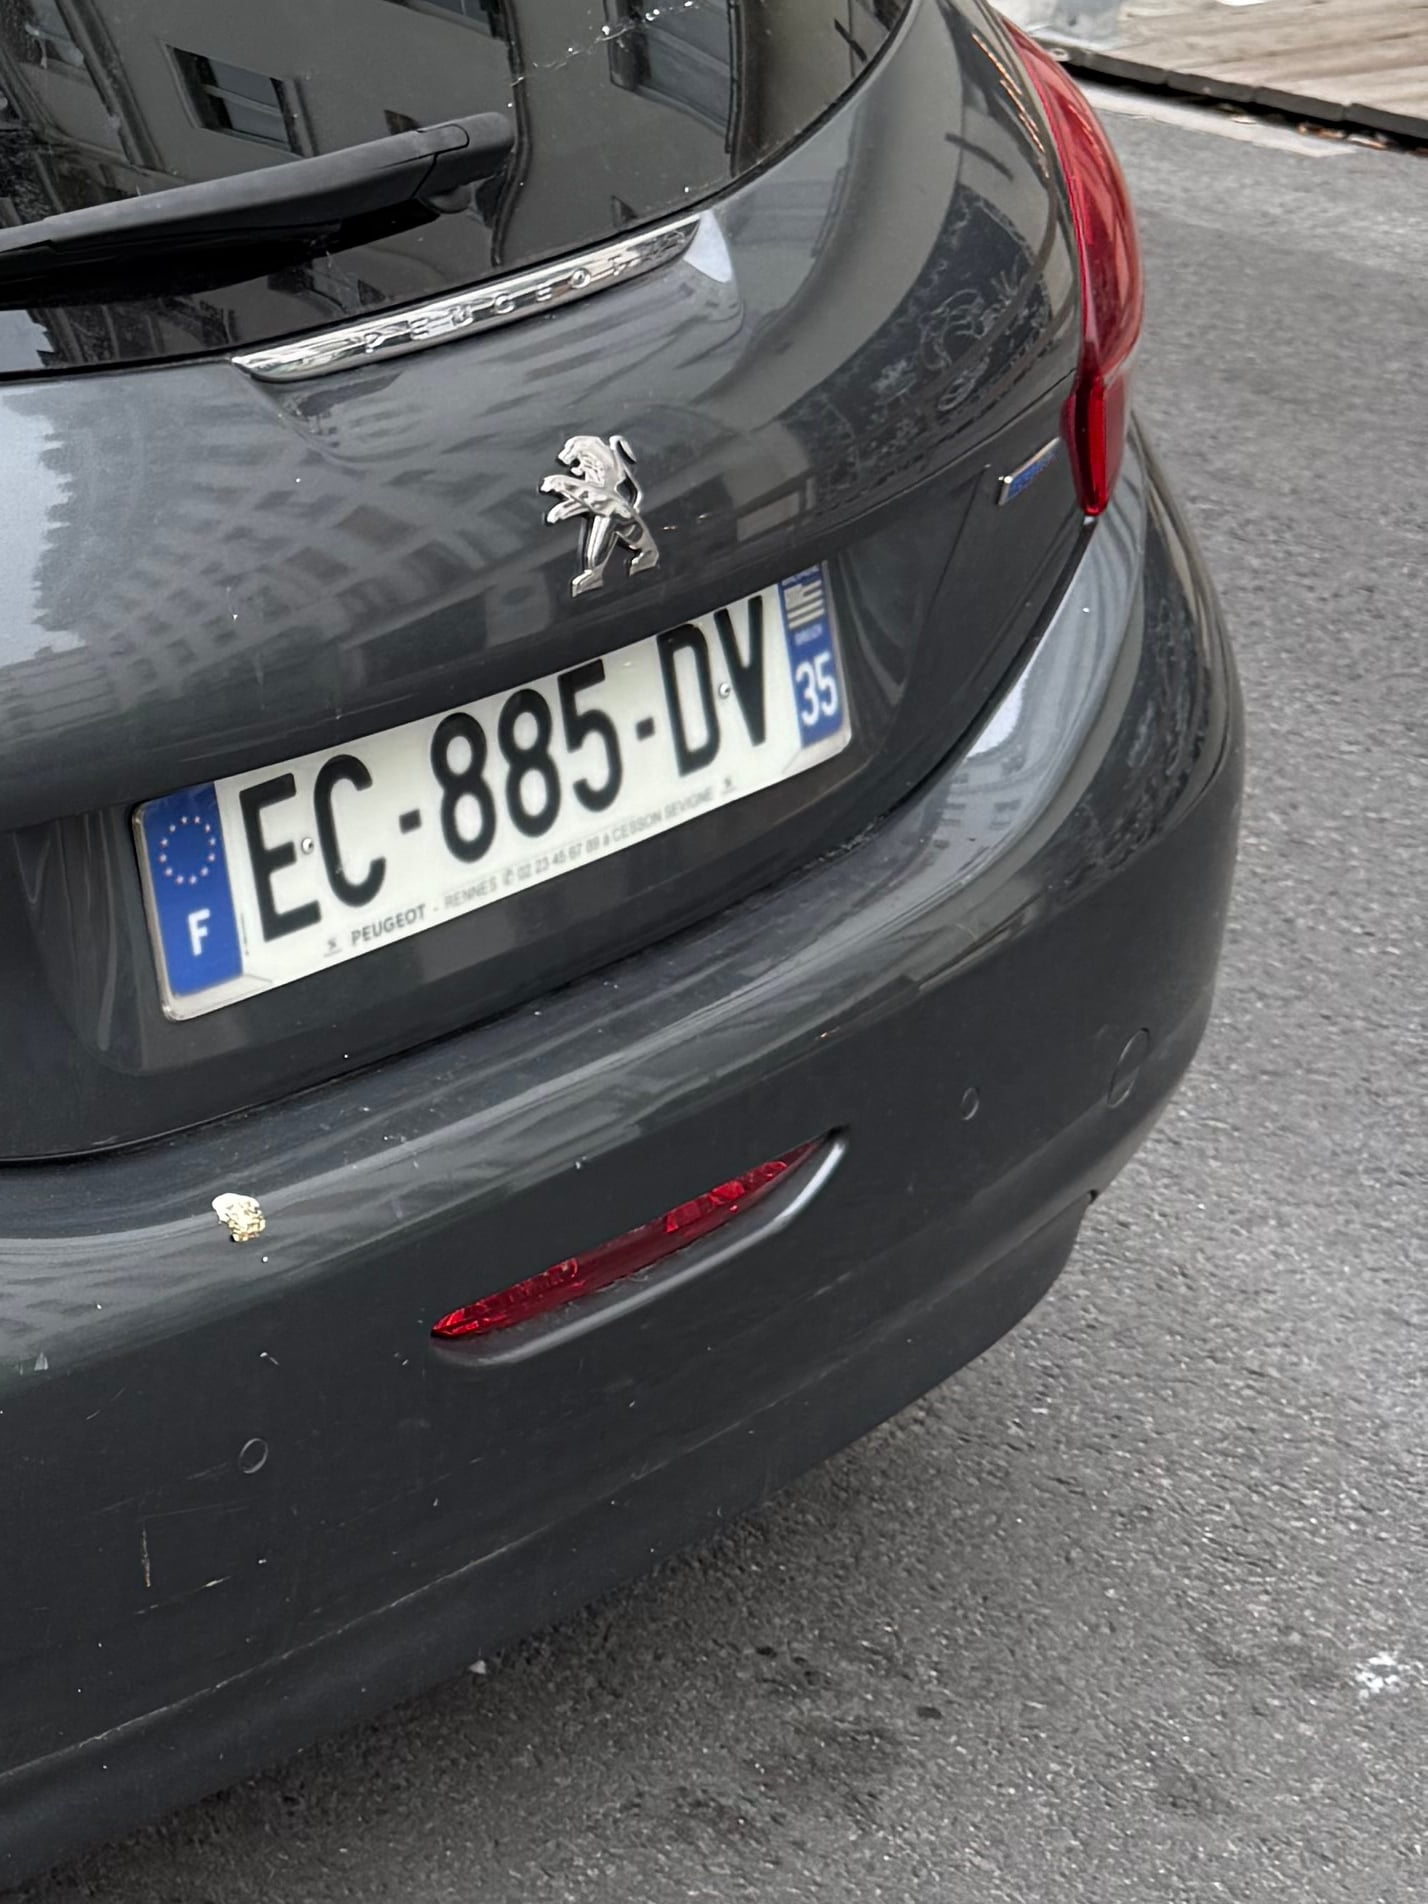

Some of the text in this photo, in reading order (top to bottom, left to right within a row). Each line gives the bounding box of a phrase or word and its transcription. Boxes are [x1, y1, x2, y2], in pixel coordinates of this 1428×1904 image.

[796, 649, 839, 727] 35
[238, 594, 769, 943] EC-885-DV
[187, 908, 211, 957] F
[350, 903, 427, 947] PEUGEOT
